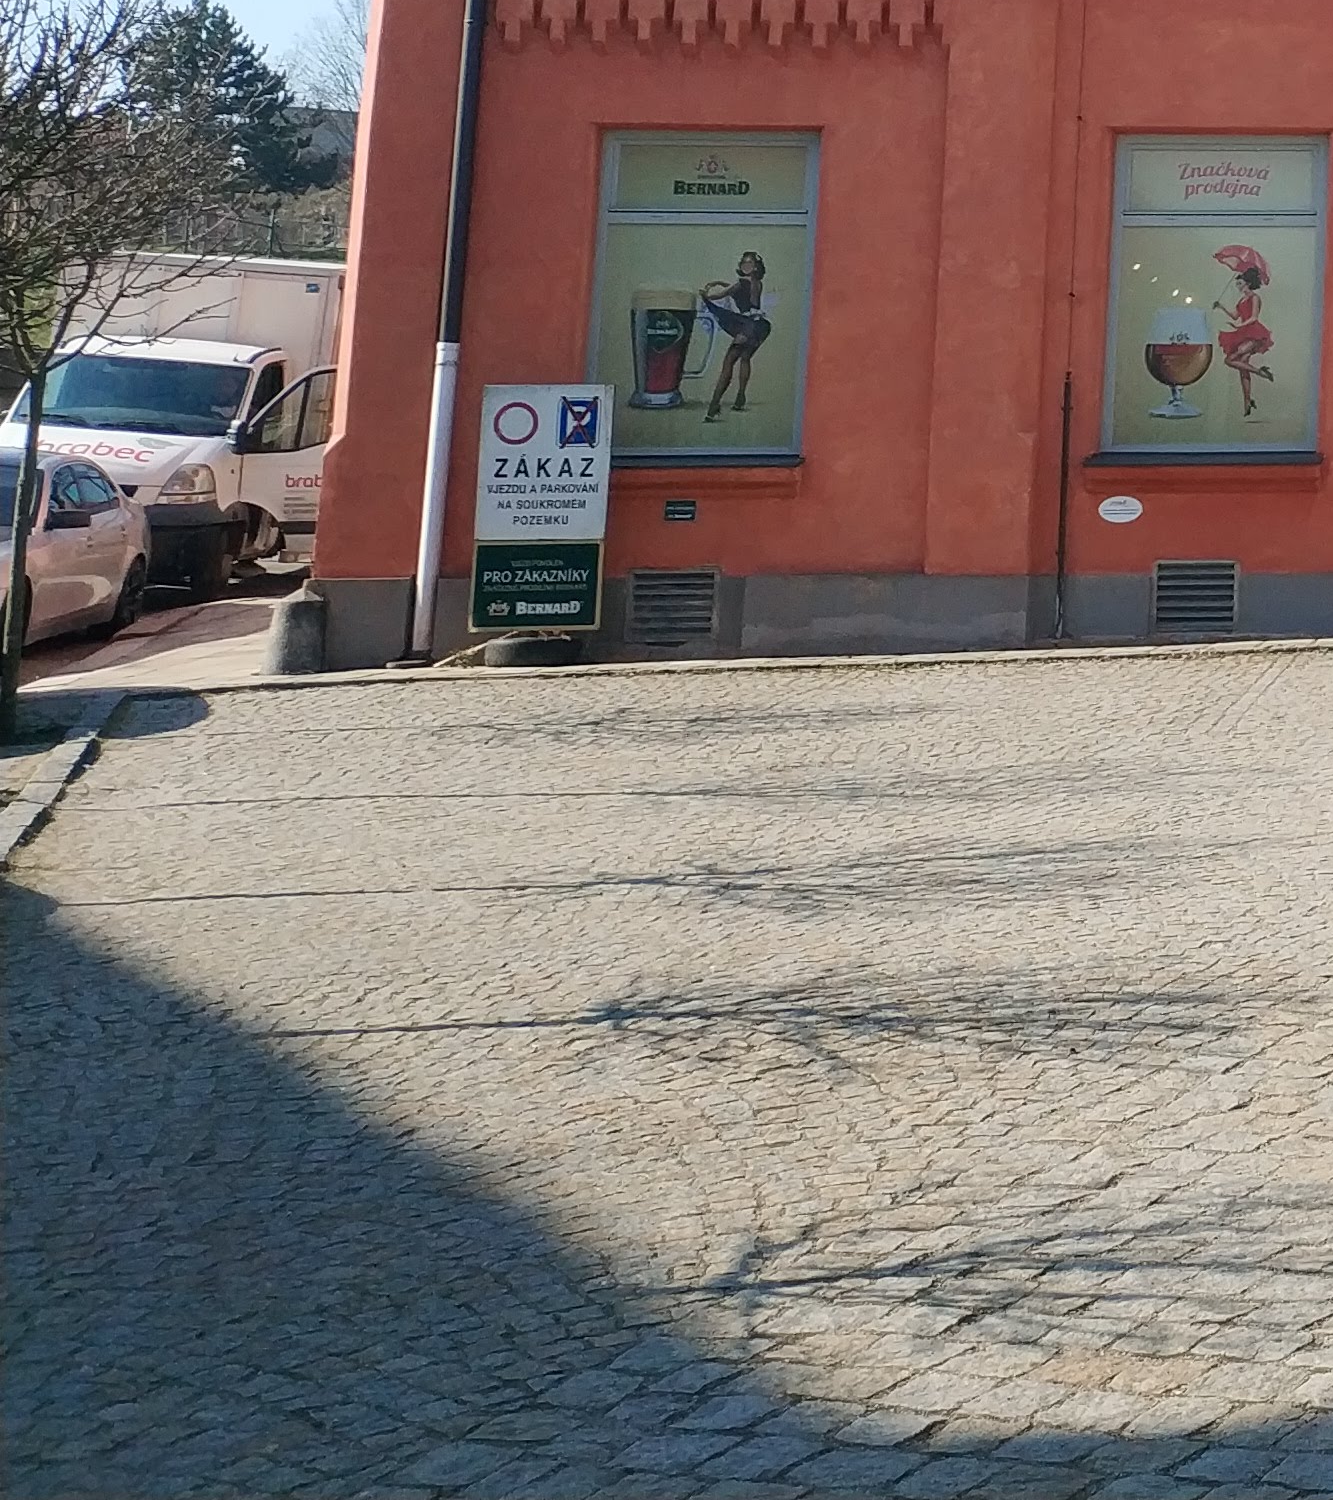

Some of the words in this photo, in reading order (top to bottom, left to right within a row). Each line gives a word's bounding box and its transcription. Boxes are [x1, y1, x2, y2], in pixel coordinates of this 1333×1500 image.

[1178, 162, 1270, 181] Značková
[673, 180, 750, 196] BERNARD
[1183, 179, 1261, 201] prodejna
[493, 454, 595, 478] ZÁKAZ
[487, 484, 527, 495] VJEZDU
[528, 484, 538, 494] A
[541, 482, 600, 494] PARKOVÁNÍ
[497, 499, 513, 510] NA
[513, 515, 570, 526] POZEMKU
[483, 570, 512, 583] PRO
[514, 567, 590, 583] ZÁKAZNÍKY
[515, 600, 581, 616] BERNARD
